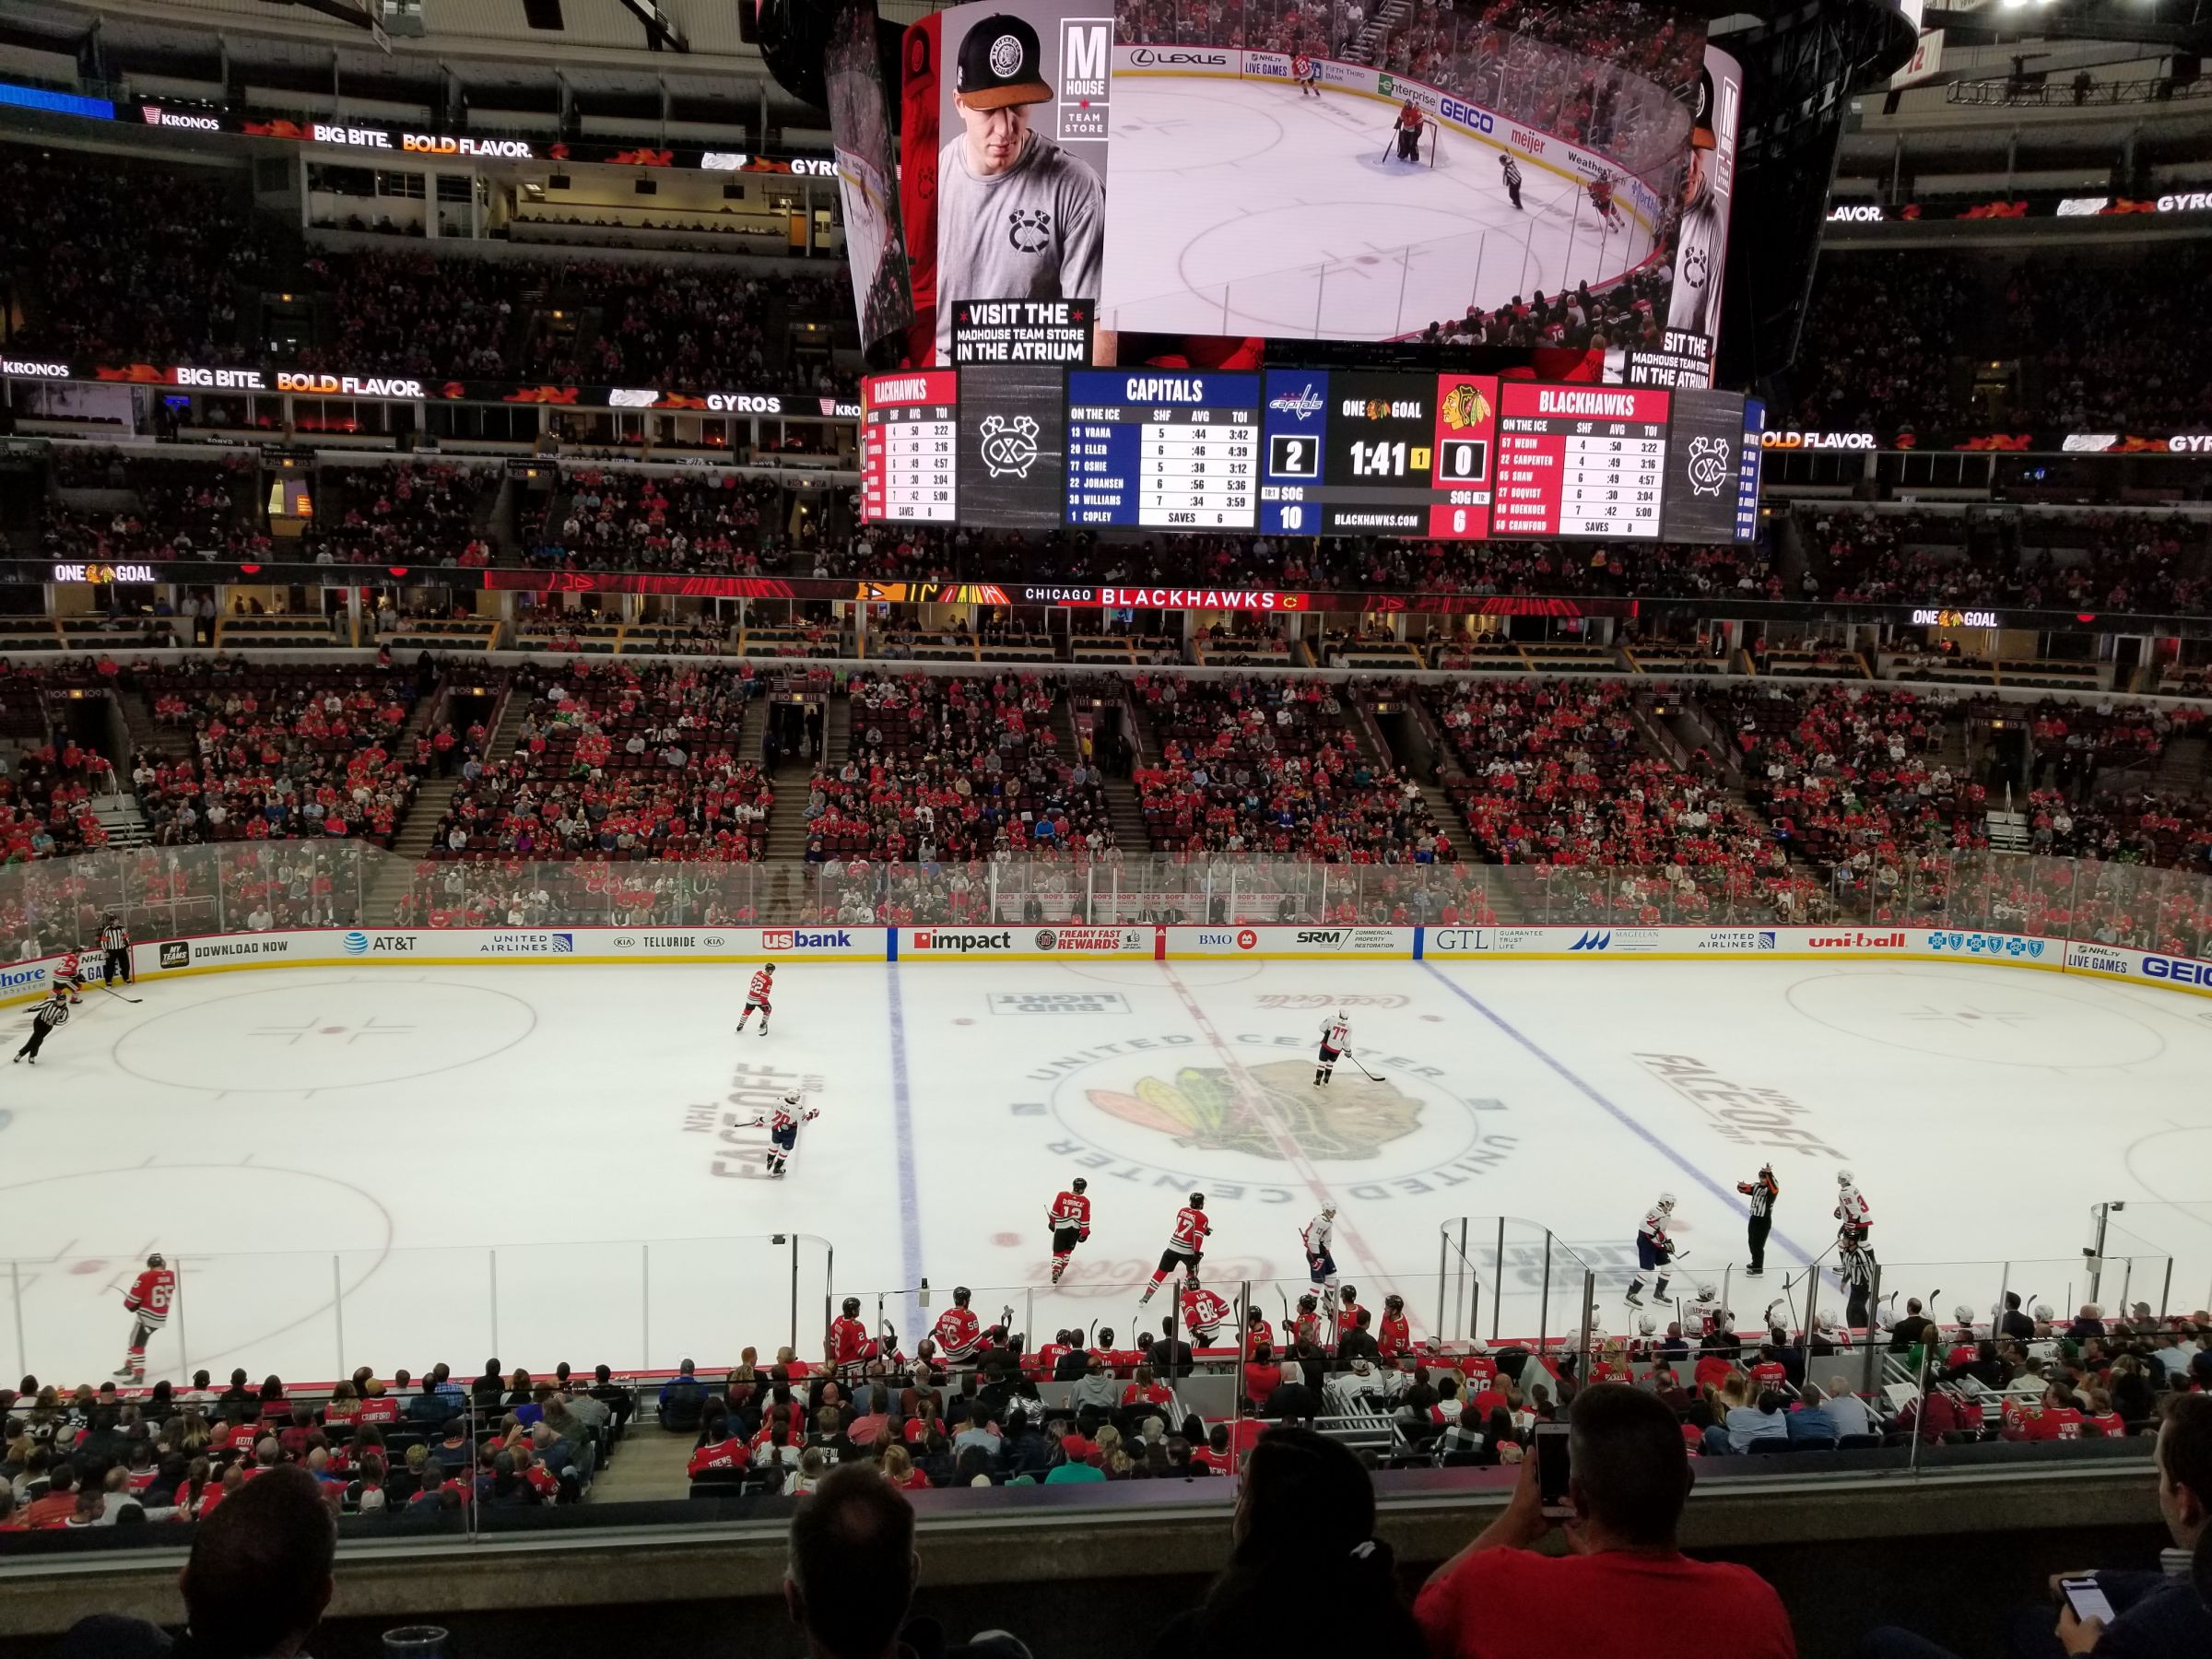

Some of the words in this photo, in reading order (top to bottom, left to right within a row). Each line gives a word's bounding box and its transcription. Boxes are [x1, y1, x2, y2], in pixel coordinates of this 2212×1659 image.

[1066, 26, 1107, 79] M
[1157, 53, 1227, 65] LEXUS
[1245, 62, 1262, 74] LIVE
[1263, 64, 1288, 76] GAMES
[1325, 72, 1344, 81] BANK
[1065, 80, 1105, 95] HOUSE
[1382, 78, 1437, 107] enterprise
[161, 113, 220, 131] KRONOS
[1069, 113, 1100, 122] TEAM
[1440, 97, 1494, 135] GEICO
[1065, 124, 1103, 133] STORE
[313, 124, 347, 145] BIG
[347, 128, 393, 149] BITE.
[402, 133, 457, 154] BOLD
[459, 138, 533, 159] FLAVOR.
[1511, 127, 1547, 155] meijer
[969, 303, 1020, 324] VISIT
[1024, 303, 1069, 324] THE
[957, 329, 1011, 341] MADHOUSE
[1013, 328, 1044, 340] TEAM
[1046, 329, 1085, 341] STORE
[957, 343, 973, 360] IN
[975, 342, 1008, 360] THE
[1011, 342, 1084, 361] ATRIUM
[1688, 335, 1708, 358] THE
[3, 360, 70, 377] KRONOS
[1632, 354, 1677, 367] MADHOUSE
[1679, 358, 1695, 371] TEAM
[176, 367, 214, 386] BIG
[216, 370, 266, 389] BITE.
[277, 372, 338, 393] BOLD
[341, 376, 425, 397] FLAVOR.
[1630, 366, 1647, 382] IN
[1650, 368, 1675, 386] THE
[1676, 371, 1709, 389] ATRIUM
[875, 378, 927, 404] BLACKHAWKS
[1126, 378, 1203, 402] CAPITALS
[706, 394, 781, 413] GYROS
[1342, 400, 1366, 417] ONE
[1391, 402, 1422, 418] GOAL
[1538, 390, 1635, 417] BLACKHAWKS
[935, 407, 947, 419] TOI
[1070, 408, 1085, 419] ON
[1086, 408, 1104, 419] THE
[1105, 409, 1121, 420] ICE
[1153, 410, 1171, 421] SHF
[1191, 411, 1210, 422] AVG
[1232, 411, 1248, 423] TOI
[1085, 427, 1112, 438] VRANA
[1229, 429, 1249, 441] 3:42
[1502, 419, 1515, 430] ON
[1516, 420, 1532, 431] THE
[1533, 421, 1547, 432] ICE
[1576, 422, 1593, 433] SHF
[1609, 424, 1626, 435] AVG
[1644, 425, 1658, 437] TOI
[1641, 441, 1657, 453] 3:22
[1803, 432, 1877, 450] FLAVOR.
[1085, 444, 1108, 455] ELLER
[1228, 446, 1248, 457] 4:39
[1286, 441, 1303, 472] 2
[1350, 441, 1406, 477] 1:41
[1454, 445, 1473, 476] 0
[1512, 454, 1554, 466] CARPENTER
[1641, 459, 1656, 470] 3:16
[1084, 461, 1108, 472] OSHIE
[1230, 464, 1248, 474] 3:12
[1083, 477, 1124, 489] JOHANSEN
[1227, 479, 1246, 490] 5:36
[1512, 471, 1534, 482] SHAW
[1639, 475, 1654, 486] 4:57
[1083, 495, 1122, 506] WILLIAMS
[1226, 497, 1246, 508] 3:59
[1280, 488, 1304, 501] SOG
[1450, 490, 1473, 505] SOG
[1637, 490, 1653, 501] 3:04
[1082, 512, 1112, 523] COPLEY
[1168, 512, 1196, 524] SAVES
[1279, 506, 1302, 529] 10
[1334, 513, 1418, 527] BLACKHAWKS.COM
[1635, 506, 1652, 518] 5:00
[1453, 509, 1466, 534] 6
[55, 564, 86, 581] ONE
[116, 565, 155, 582] GOAL
[1025, 587, 1092, 602] CHICAGO
[1101, 588, 1275, 608] BLACKHAWKS
[1912, 608, 1938, 624] ONE
[1963, 611, 1997, 628] GOAL
[643, 936, 696, 947] TELLURIDE
[931, 928, 1011, 952] impact
[1058, 929, 1097, 938] FREAKY
[1097, 929, 1122, 938] FAST
[1198, 934, 1232, 945] BMO
[1296, 931, 1341, 944] SRM
[1436, 929, 1488, 950] GTL
[1615, 930, 1659, 938] MAGELLAN
[1808, 933, 1906, 947] uni-ball
[169, 945, 182, 953] MY
[194, 941, 259, 958] DOWNLOAD
[262, 940, 288, 953] NOW
[372, 936, 418, 951] AT&T
[480, 944, 548, 952] AIRLINES
[1057, 938, 1120, 949] REWARDS
[162, 952, 187, 961] TEAMS
[2068, 955, 2089, 968] LIVE
[2091, 958, 2127, 974] GAMES
[1333, 1026, 1348, 1041] 77
[1026, 1033, 1194, 1083] UNITED
[968, 1319, 980, 1331] 56
[361, 1411, 390, 1421] CRAWFORD
